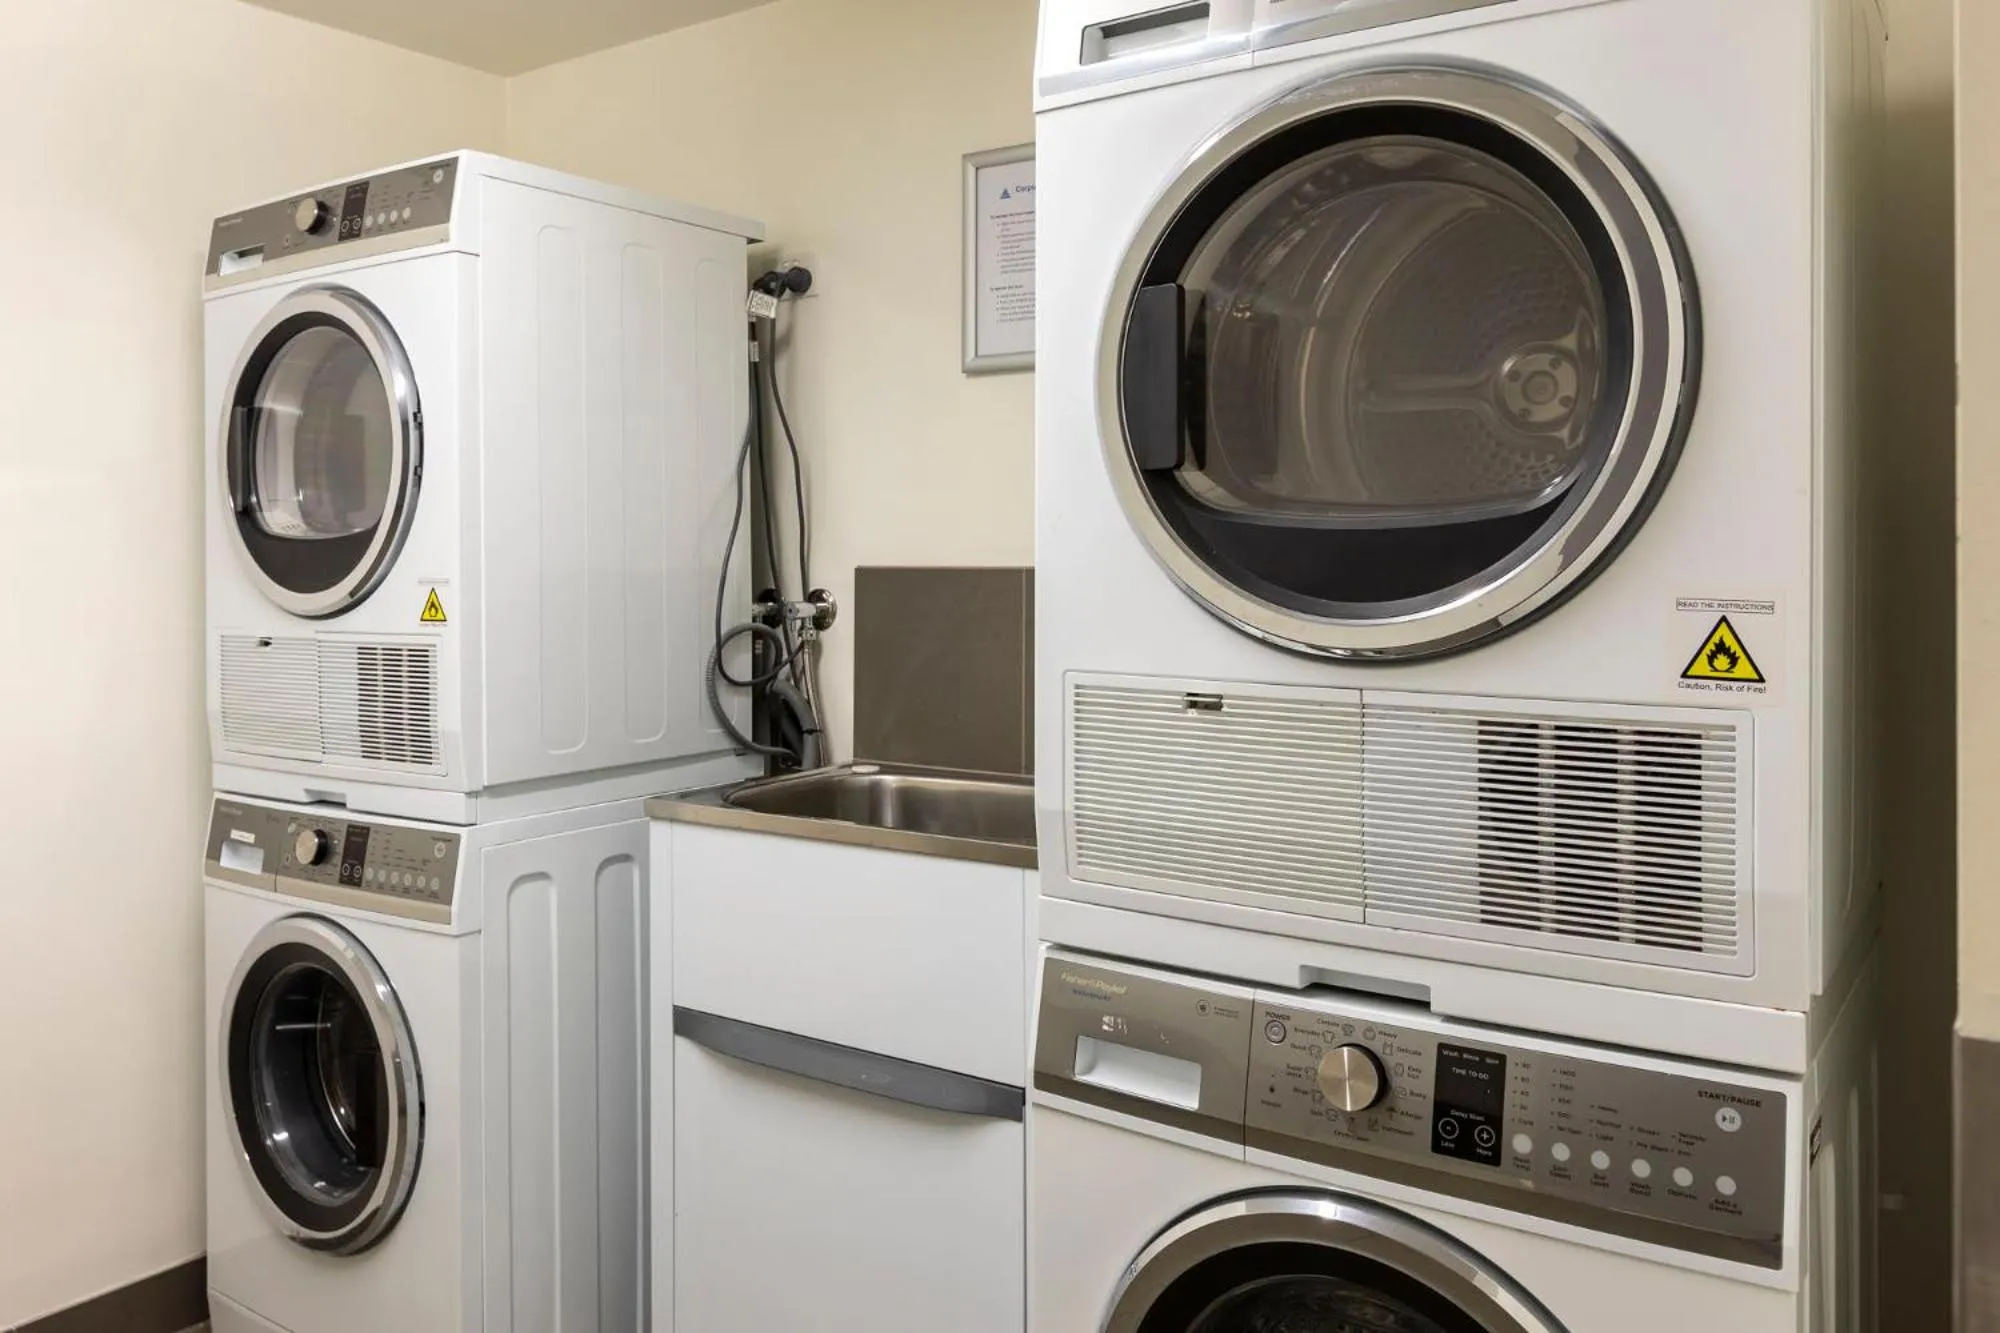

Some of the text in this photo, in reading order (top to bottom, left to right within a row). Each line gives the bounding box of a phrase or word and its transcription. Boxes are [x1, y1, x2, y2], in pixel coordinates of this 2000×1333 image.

[1717, 602, 1774, 611] INSTRUCTIONS
[1715, 683, 1733, 692] Risk
[1736, 685, 1745, 693] of
[1265, 1011, 1291, 1021] POWER
[1468, 1069, 1477, 1078] TO
[1478, 1072, 1489, 1080] GO
[1697, 1090, 1763, 1108] START/PAUSE
